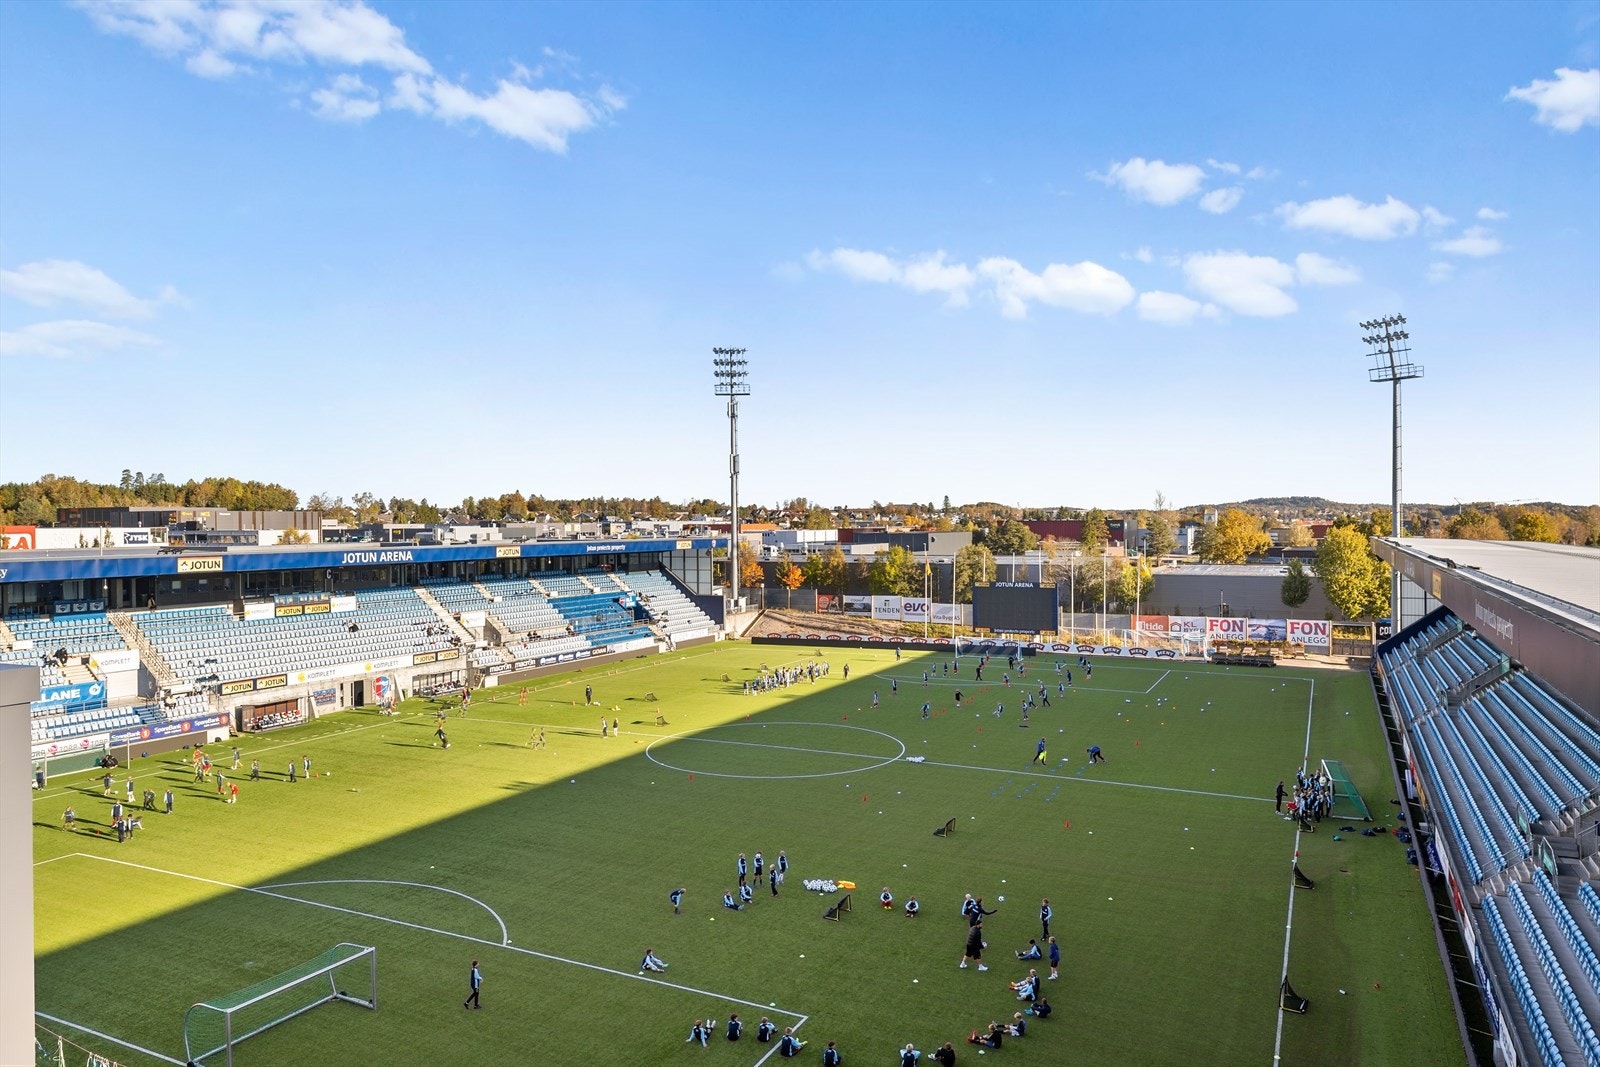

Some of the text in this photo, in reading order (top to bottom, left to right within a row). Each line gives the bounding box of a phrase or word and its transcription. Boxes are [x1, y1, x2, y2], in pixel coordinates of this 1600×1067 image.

[342, 550, 413, 564] JOTUN ARENA
[190, 560, 221, 570] JOTUN
[904, 602, 929, 612] evo
[1209, 619, 1244, 632] FON
[1289, 622, 1327, 635] FON
[1291, 636, 1327, 644] ANLEGG
[1103, 646, 1120, 654] MENY
[100, 657, 131, 666] KOMPLETT
[373, 660, 399, 669] KOMPLETT
[514, 659, 536, 668] macron
[489, 663, 512, 672] macron
[307, 670, 336, 679] KOMPLETT
[265, 678, 285, 687] JOTUN
[231, 683, 252, 692] JOTUN
